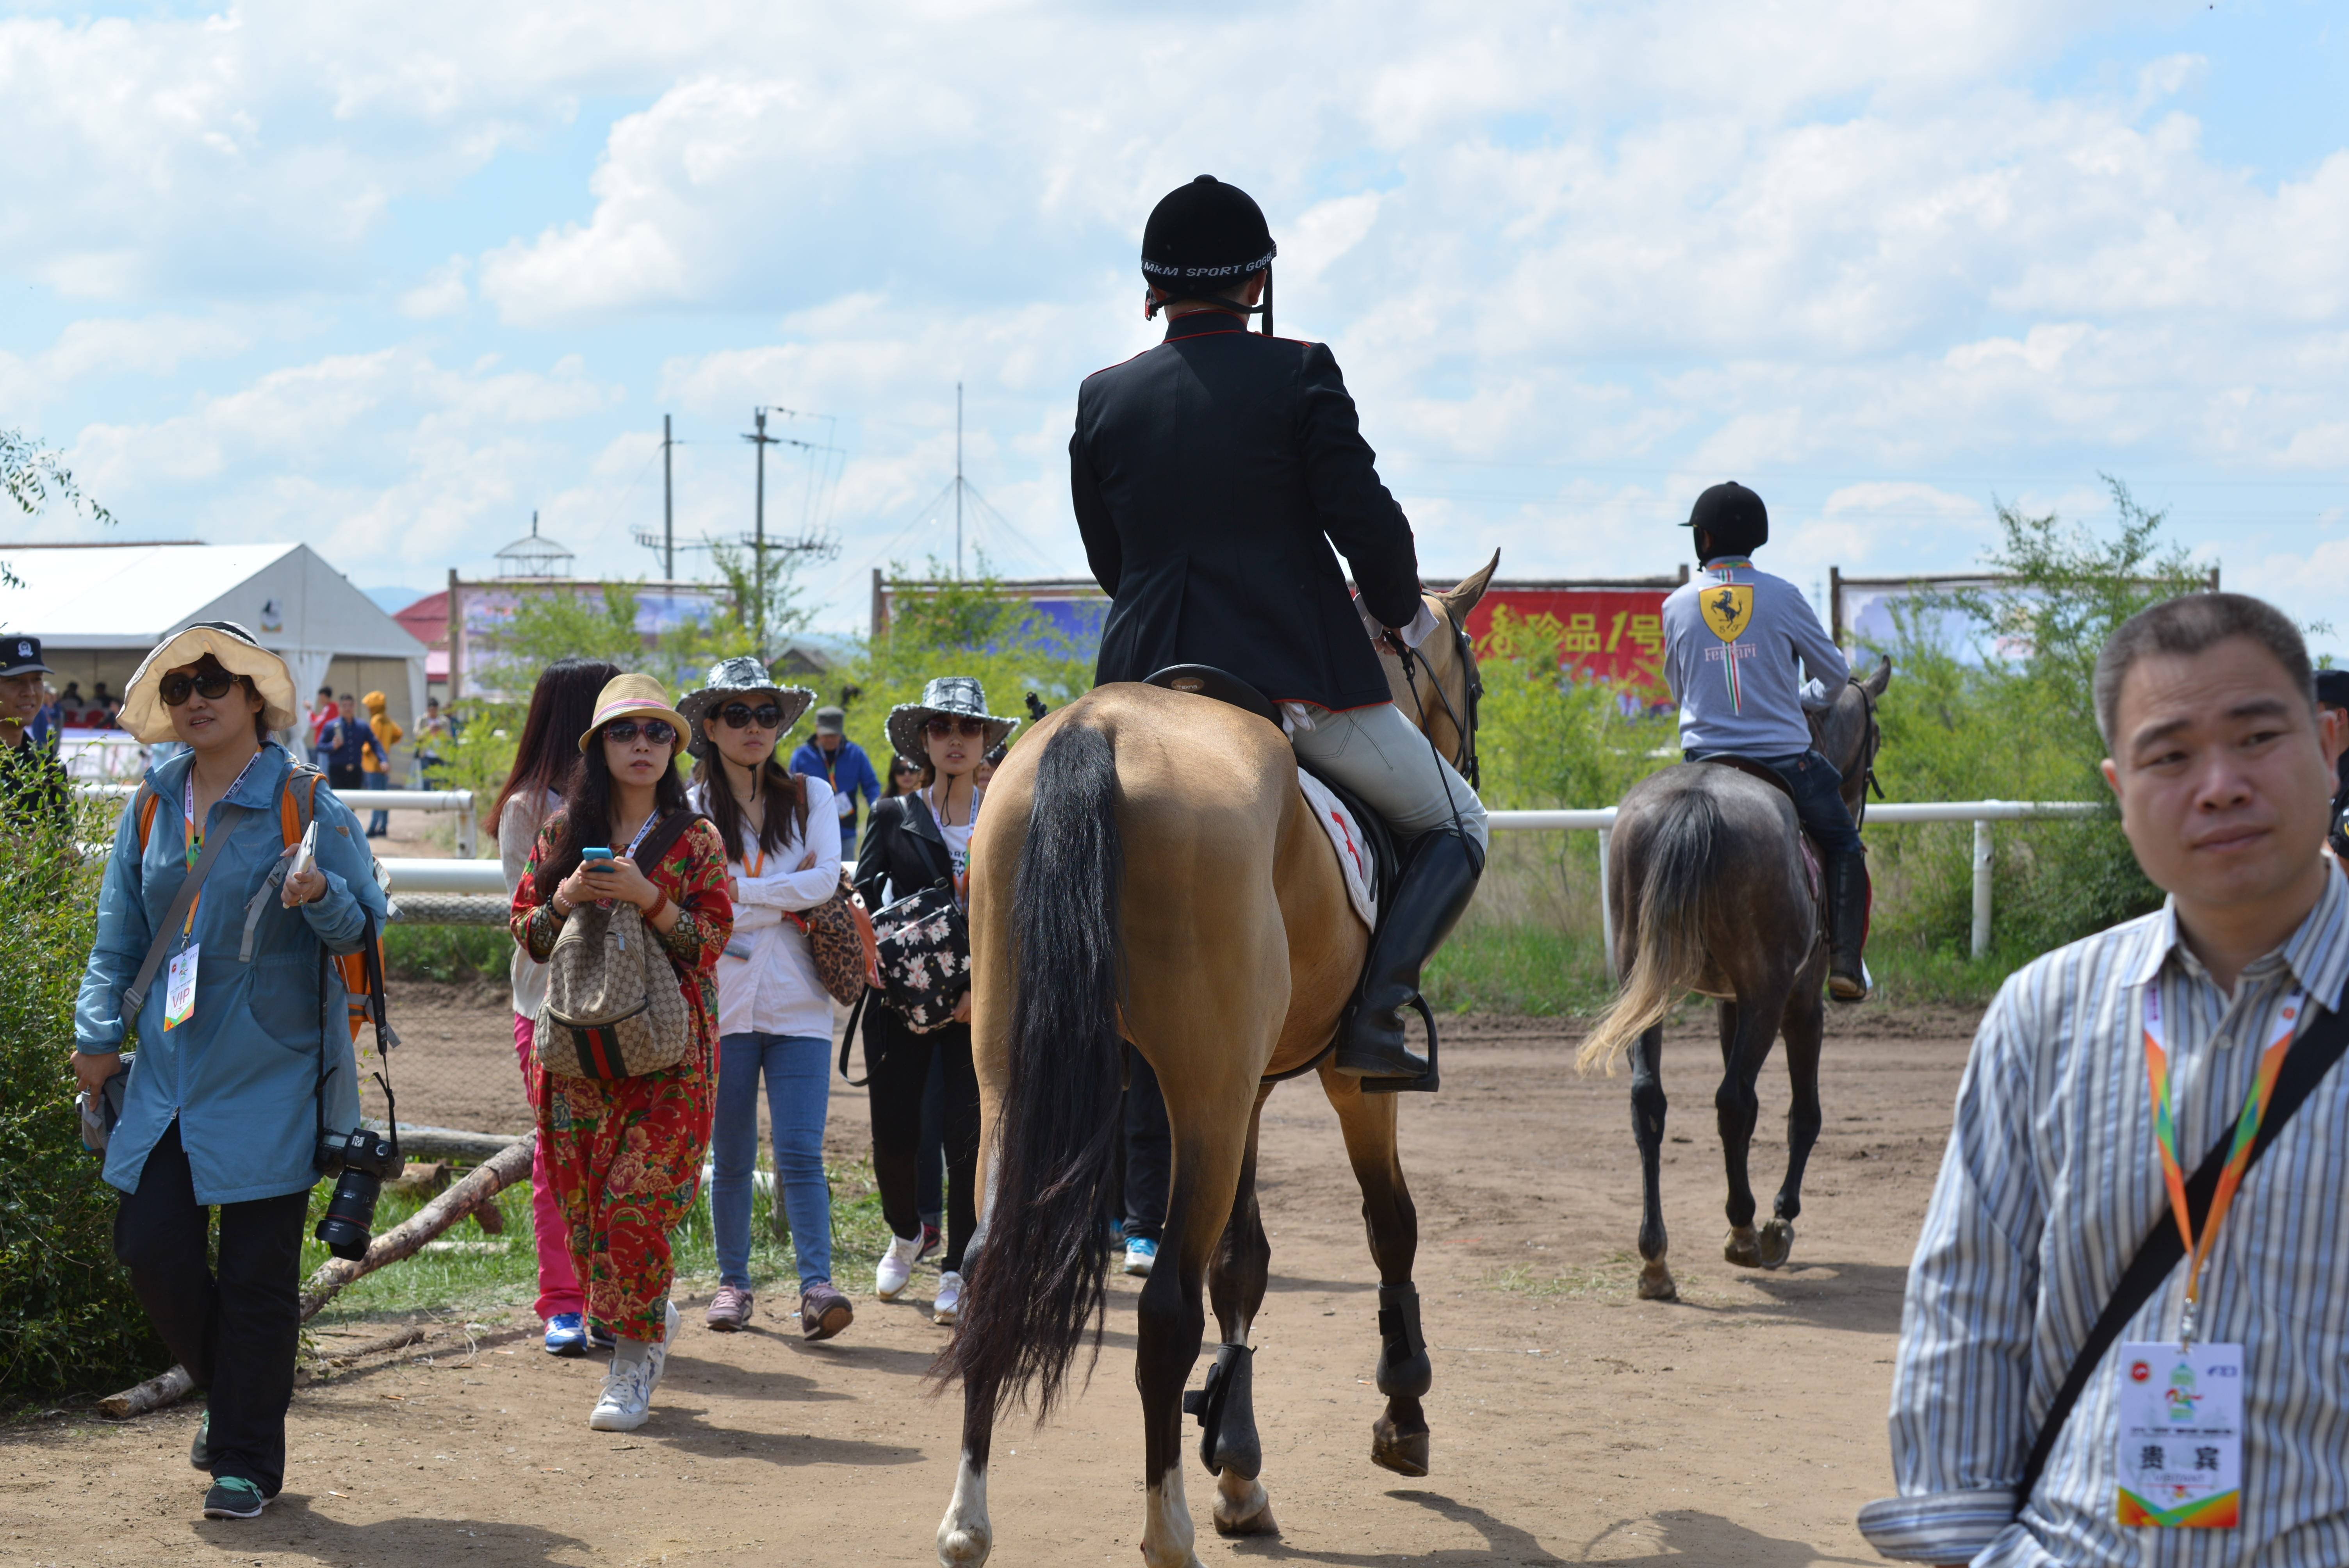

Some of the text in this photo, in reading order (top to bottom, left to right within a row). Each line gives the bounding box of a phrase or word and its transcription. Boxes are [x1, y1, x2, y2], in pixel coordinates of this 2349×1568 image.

[1186, 265, 1242, 276] SPORT
[1705, 643, 1756, 662] Ferrari
[173, 987, 190, 1008] VIP
